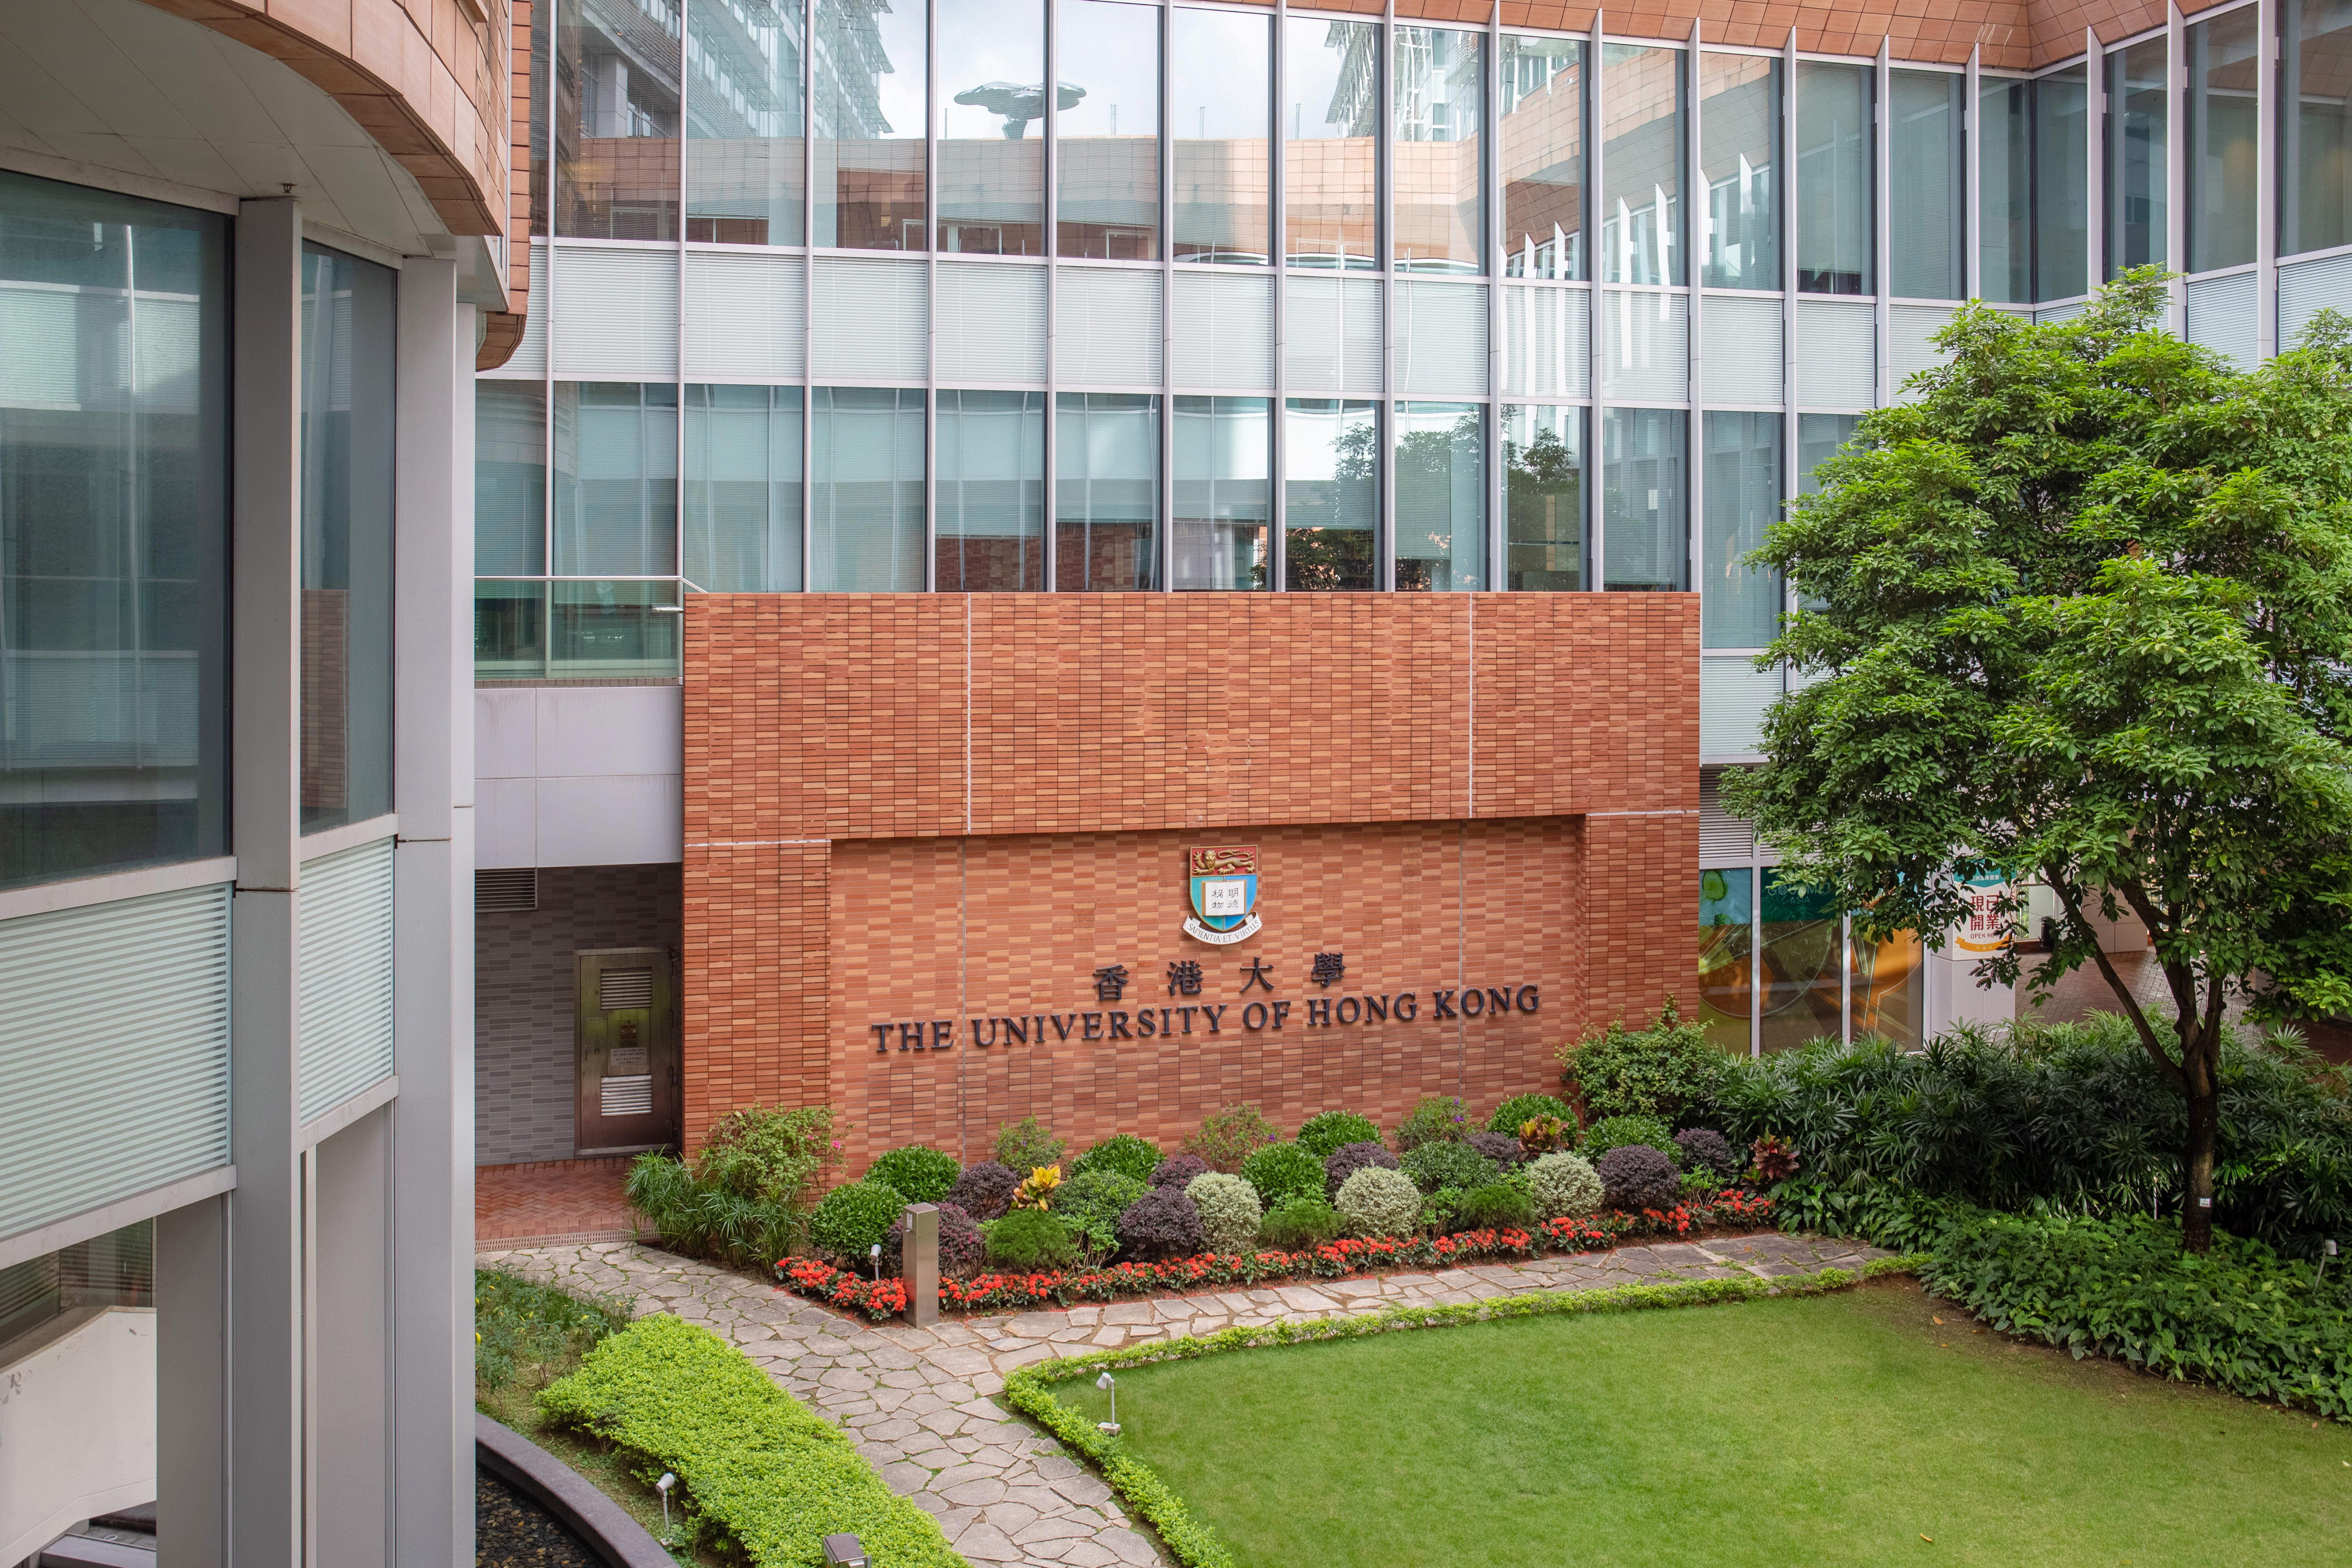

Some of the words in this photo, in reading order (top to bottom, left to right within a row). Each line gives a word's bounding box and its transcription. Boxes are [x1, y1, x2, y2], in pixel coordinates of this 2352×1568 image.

[1790, 896, 1810, 904] ASIA
[1188, 923, 1221, 943] SAPIENTIA
[1223, 934, 1232, 943] ET
[1235, 920, 1260, 939] VIRTUS
[1970, 913, 2001, 931] 開業
[1093, 952, 1346, 1002] 香港大學
[871, 1019, 954, 1051] THE
[972, 1003, 1228, 1047] UNIVERSITY
[1243, 999, 1291, 1029] OF
[1307, 992, 1418, 1025] HONG
[1433, 983, 1540, 1018] KONG
